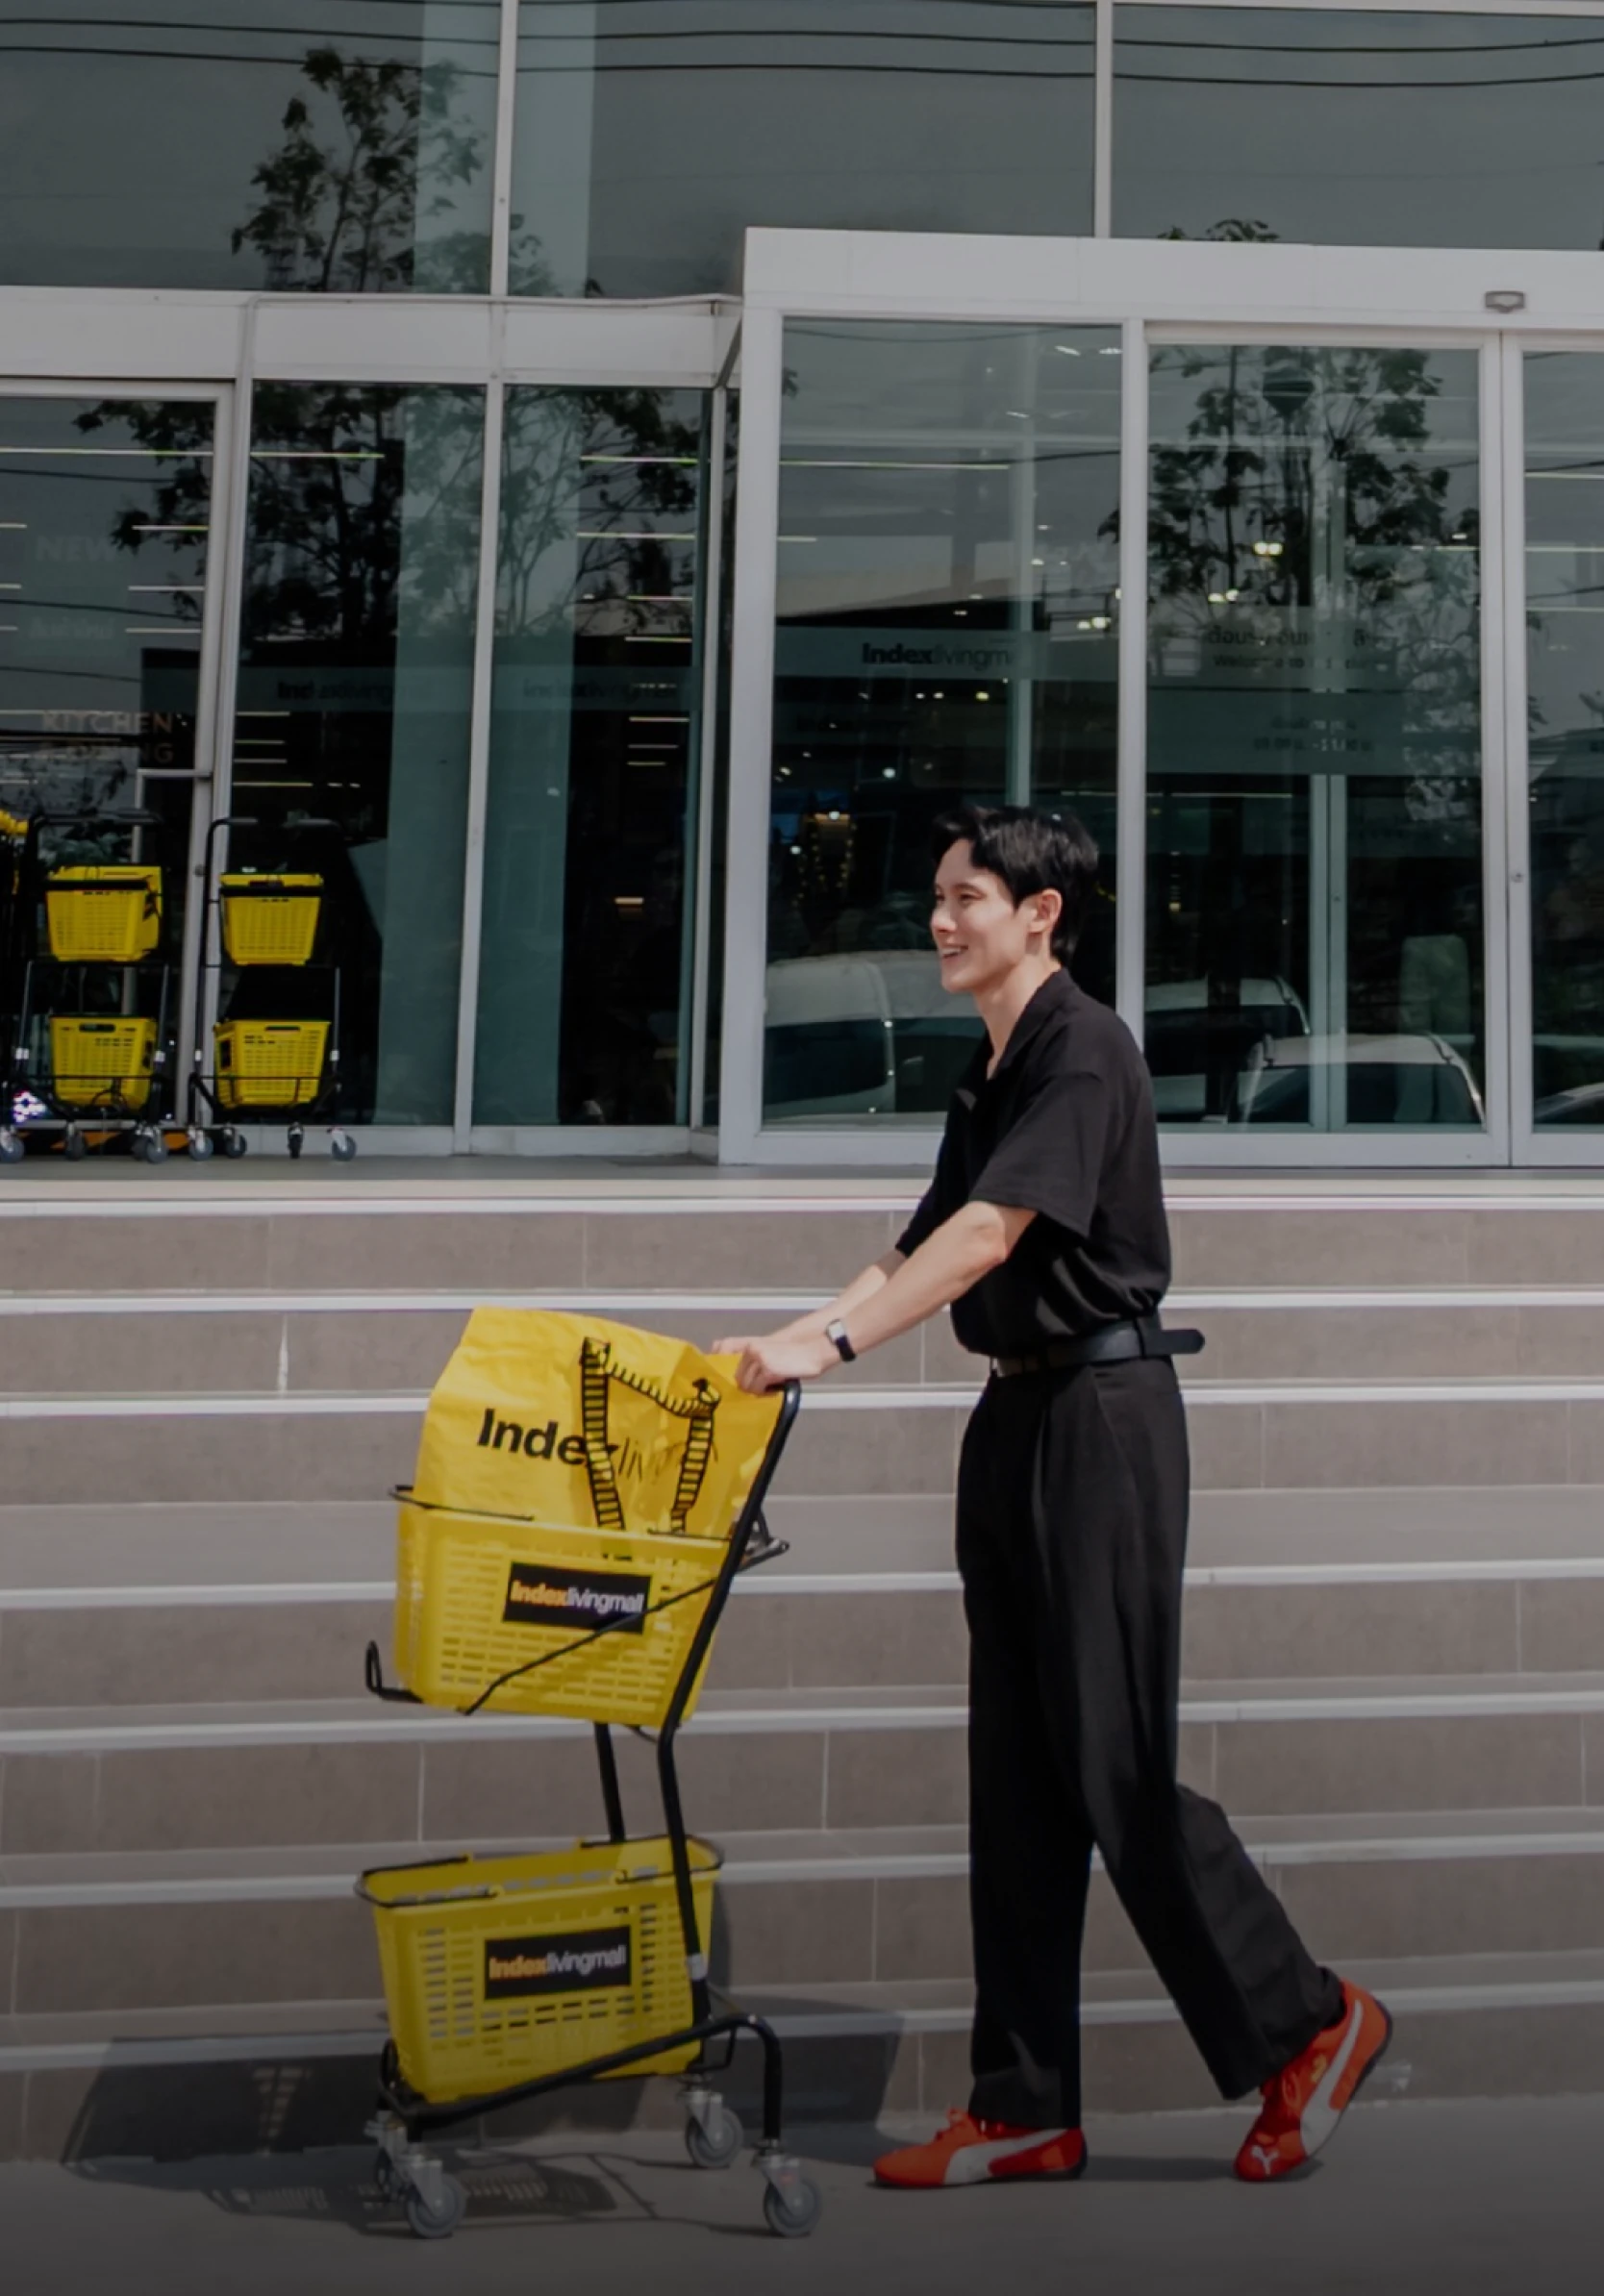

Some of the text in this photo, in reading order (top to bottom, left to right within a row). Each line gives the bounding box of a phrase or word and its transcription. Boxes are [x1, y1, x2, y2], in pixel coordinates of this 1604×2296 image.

[42, 711, 172, 734] KITCHEN
[511, 1580, 644, 1614] Indexlivingmall
[489, 1944, 627, 1980] Indexlivingmall
